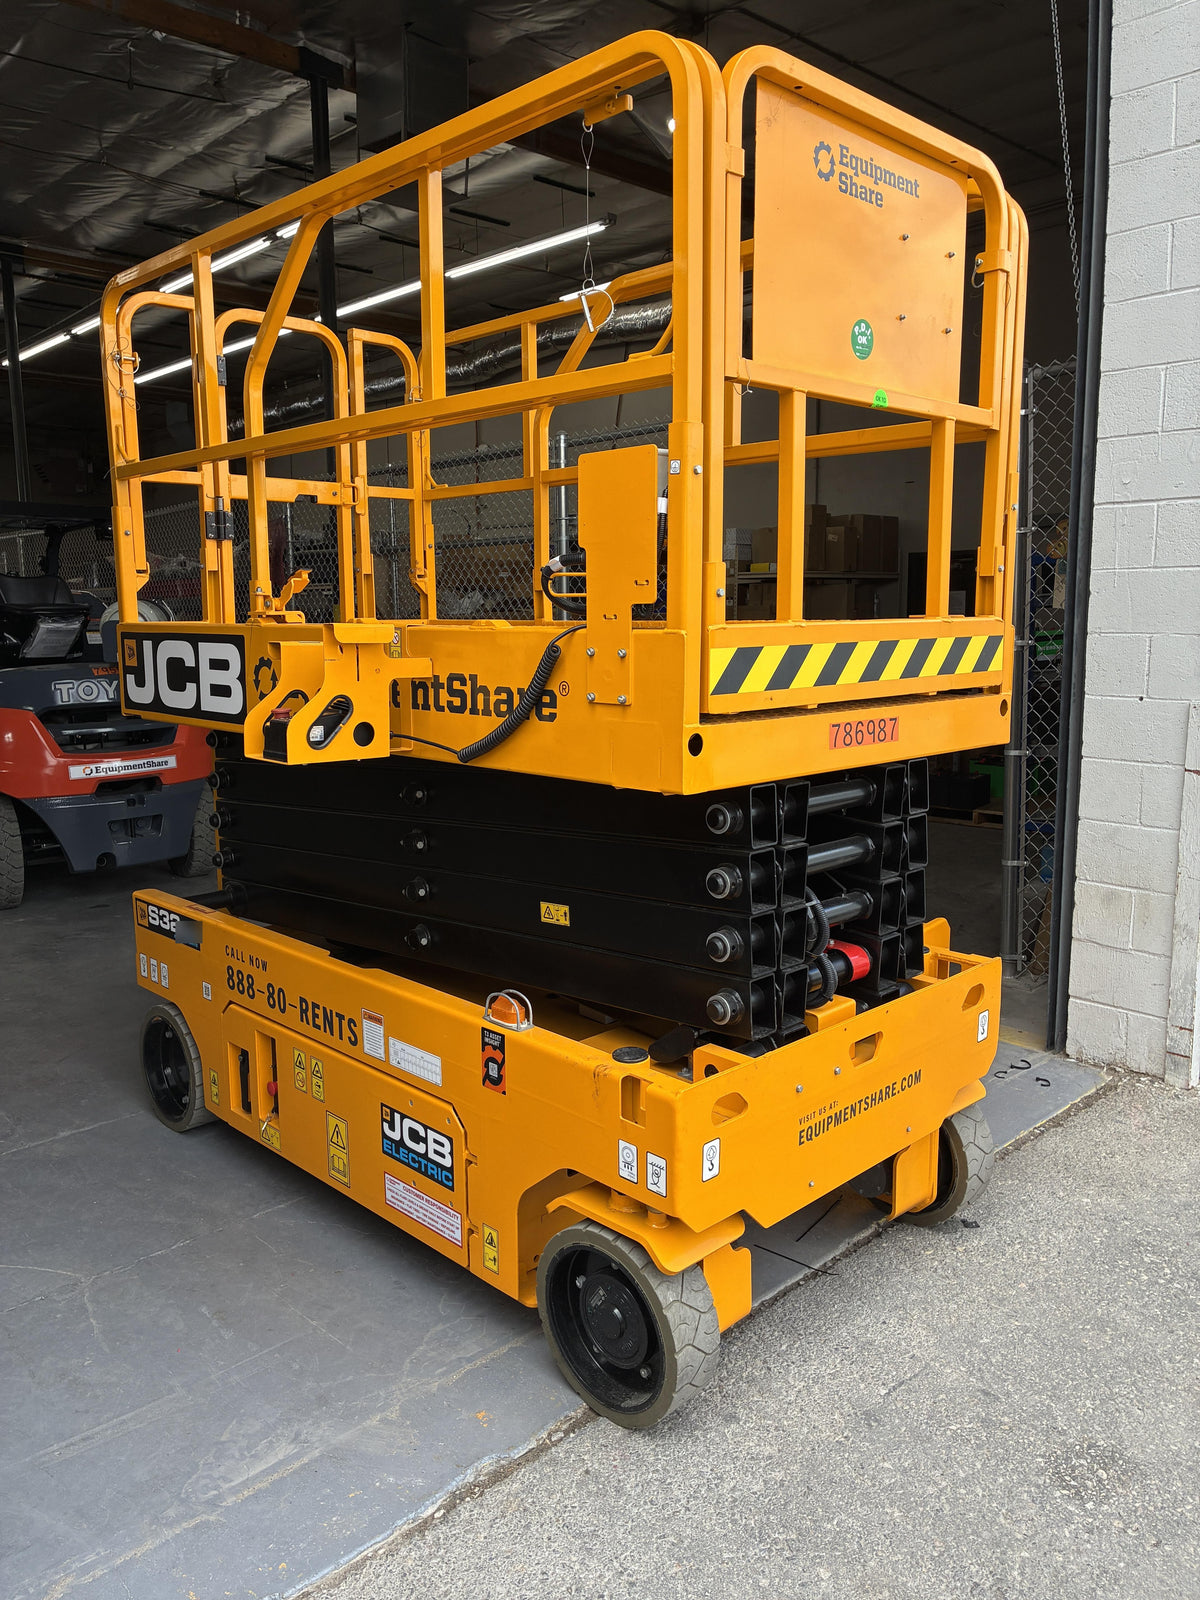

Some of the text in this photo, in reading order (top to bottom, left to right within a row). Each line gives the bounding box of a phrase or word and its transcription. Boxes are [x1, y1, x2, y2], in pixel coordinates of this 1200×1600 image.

[838, 144, 920, 198] Equipment
[838, 171, 884, 208] Share
[857, 335, 868, 344] OK
[126, 640, 243, 715] JCB
[831, 717, 897, 747] 786987
[94, 759, 169, 774] EquipmentShare
[225, 945, 268, 973] CALL NOW
[226, 965, 358, 1047] 888-80-RENTS
[798, 1069, 922, 1146] EQUIPMENTSHARE.COM
[798, 1100, 839, 1125] VISIT US AT:
[383, 1112, 452, 1168] JCB
[383, 1138, 453, 1187] ELECTRIC
